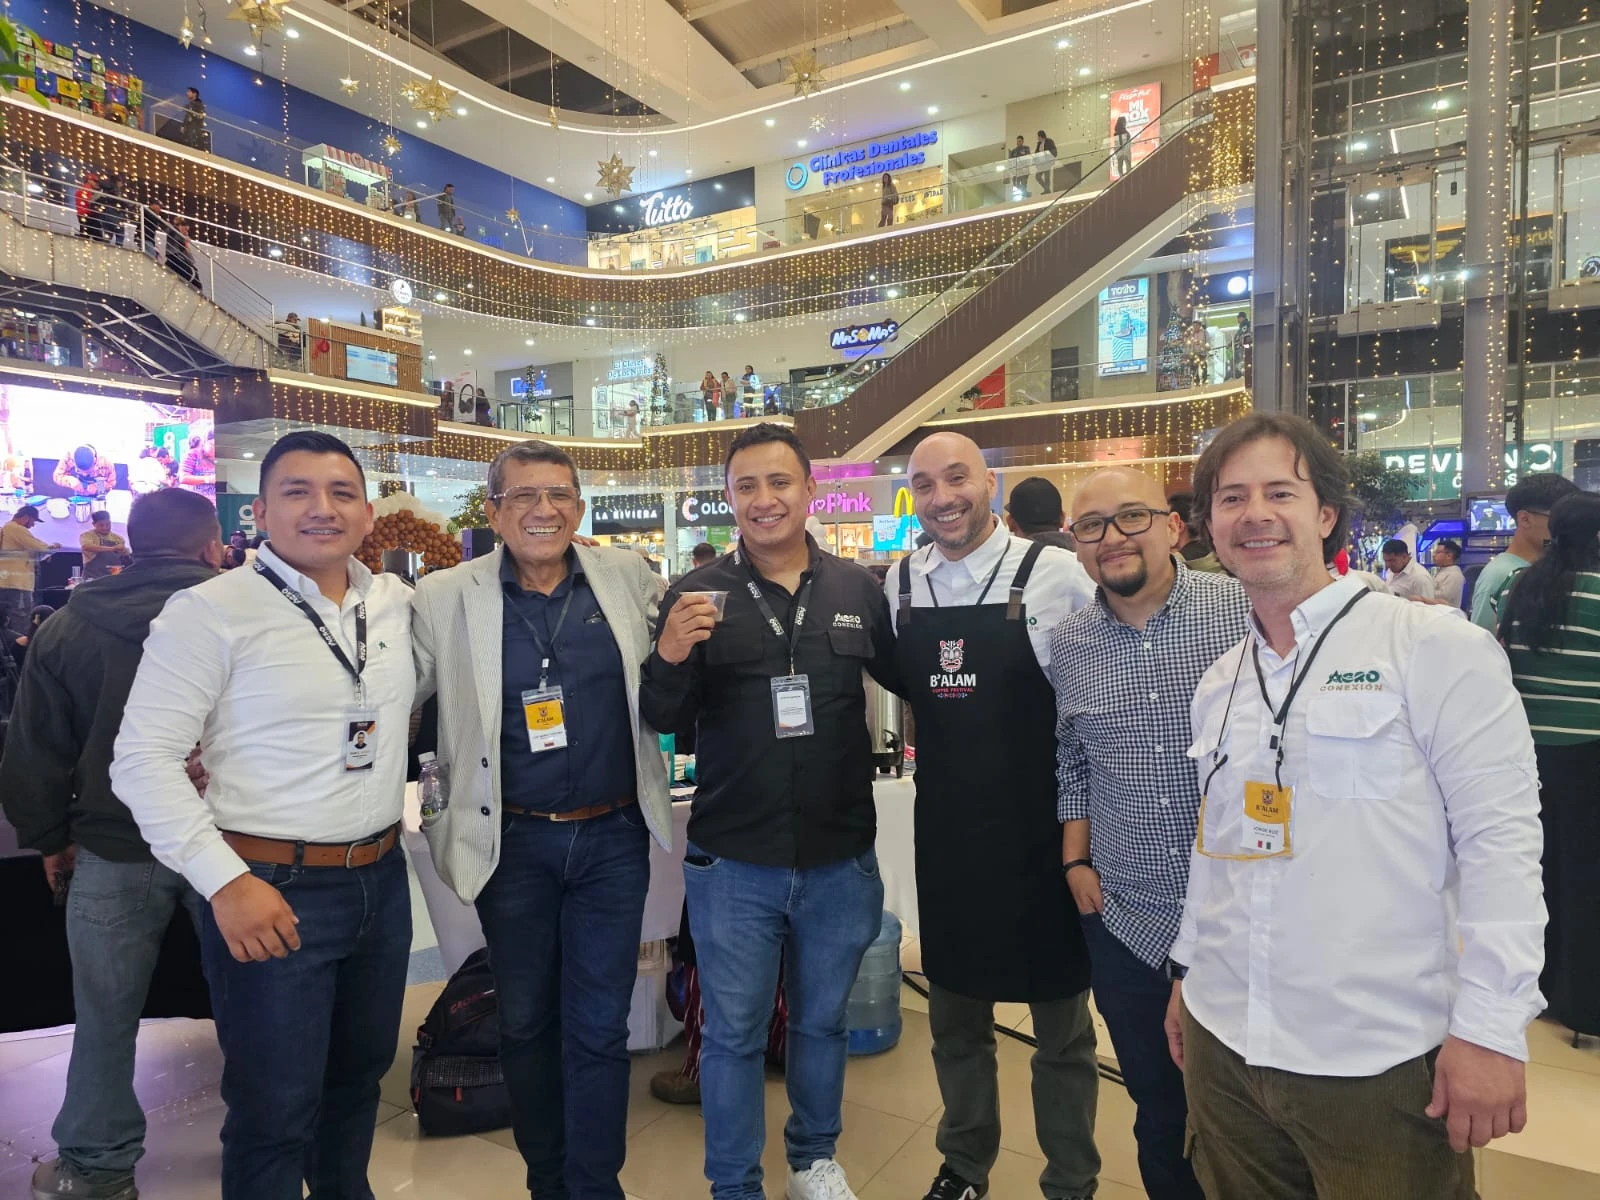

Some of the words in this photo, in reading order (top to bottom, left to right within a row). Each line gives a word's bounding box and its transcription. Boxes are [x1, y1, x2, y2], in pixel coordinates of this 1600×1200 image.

[809, 149, 866, 173] Clínicas
[867, 130, 938, 159] Dentales
[823, 151, 926, 186] Profesionales
[639, 191, 694, 226] Tutto
[595, 511, 609, 520] LA
[612, 509, 658, 519] RIVIERA
[930, 673, 977, 688] B'ALAM
